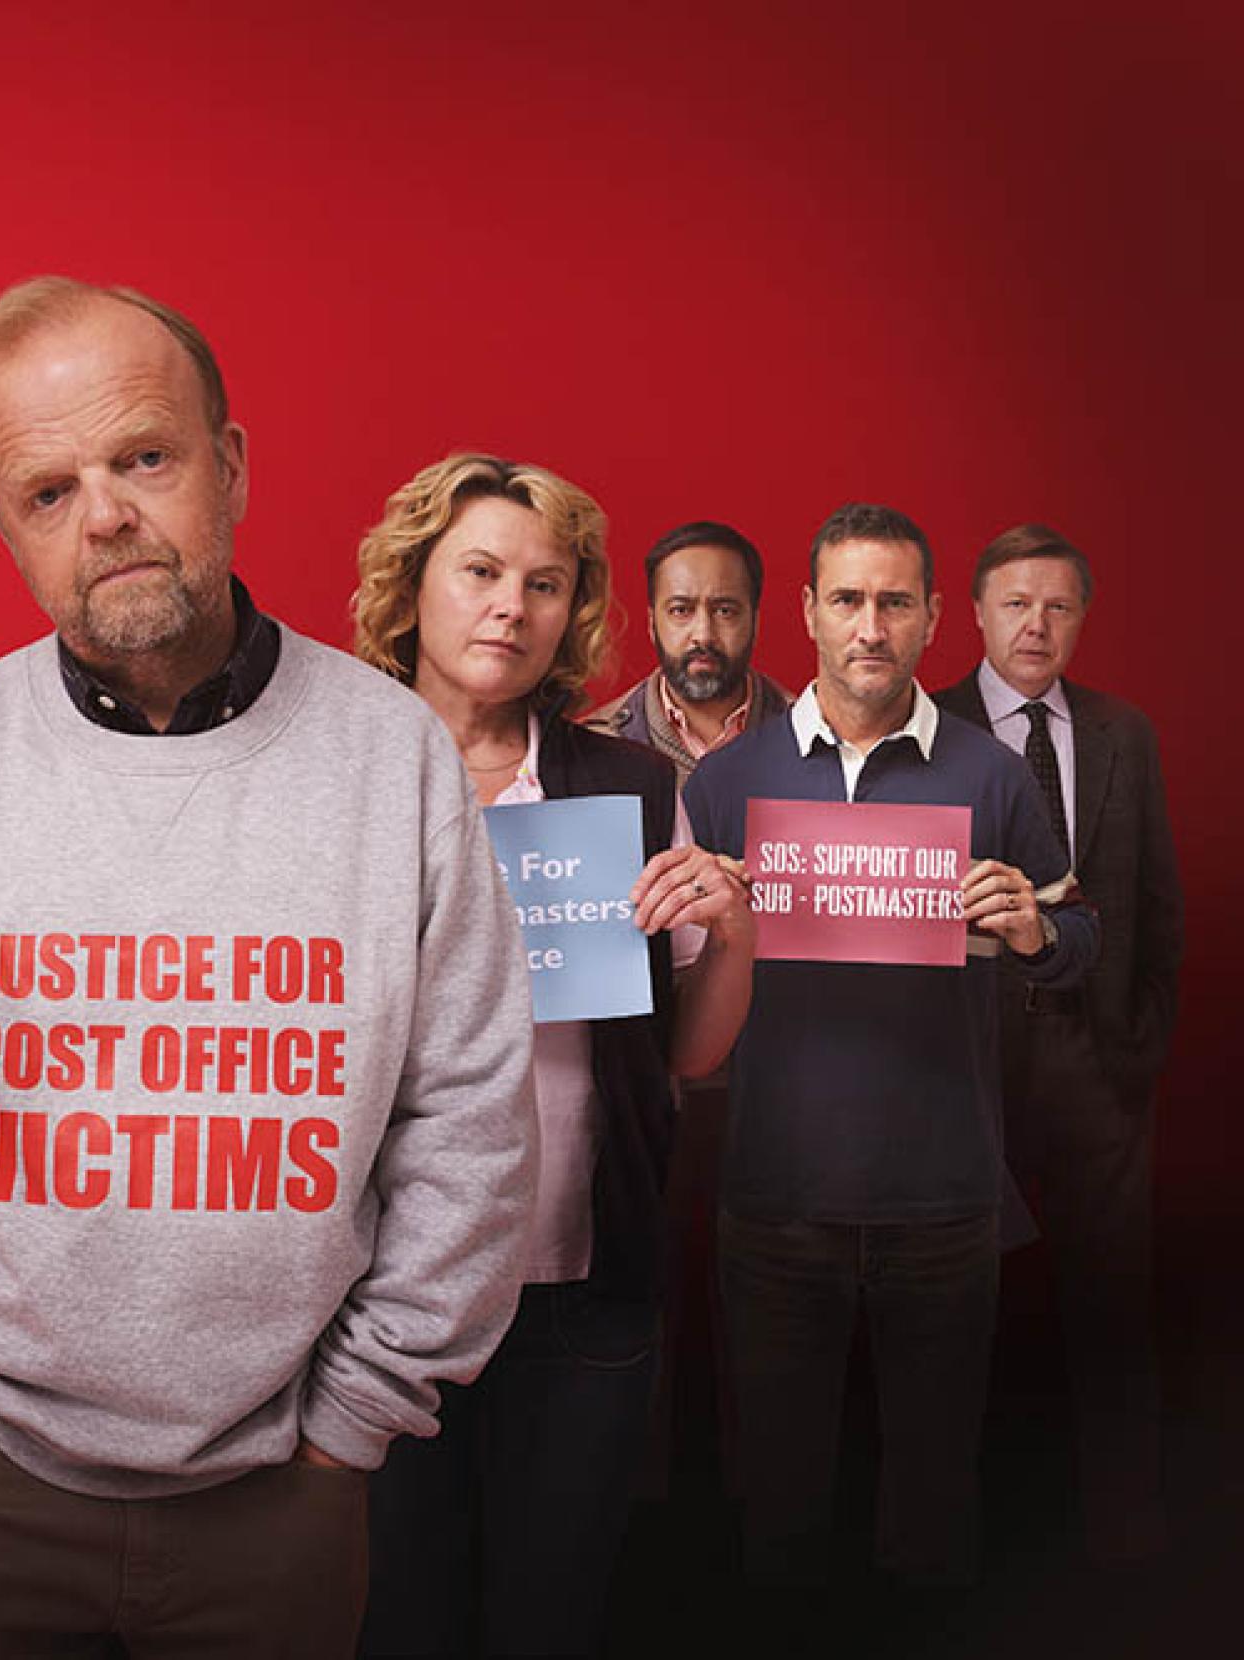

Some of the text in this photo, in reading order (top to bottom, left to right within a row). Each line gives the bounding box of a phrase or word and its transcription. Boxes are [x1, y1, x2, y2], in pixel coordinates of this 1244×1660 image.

[520, 852, 581, 881] For
[760, 841, 957, 880] SOS: SUPPORT OUR
[751, 881, 793, 913] SUB
[814, 885, 965, 919] POSTMASTERS
[232, 935, 345, 1004] FOR
[140, 1024, 345, 1096] OFFICE
